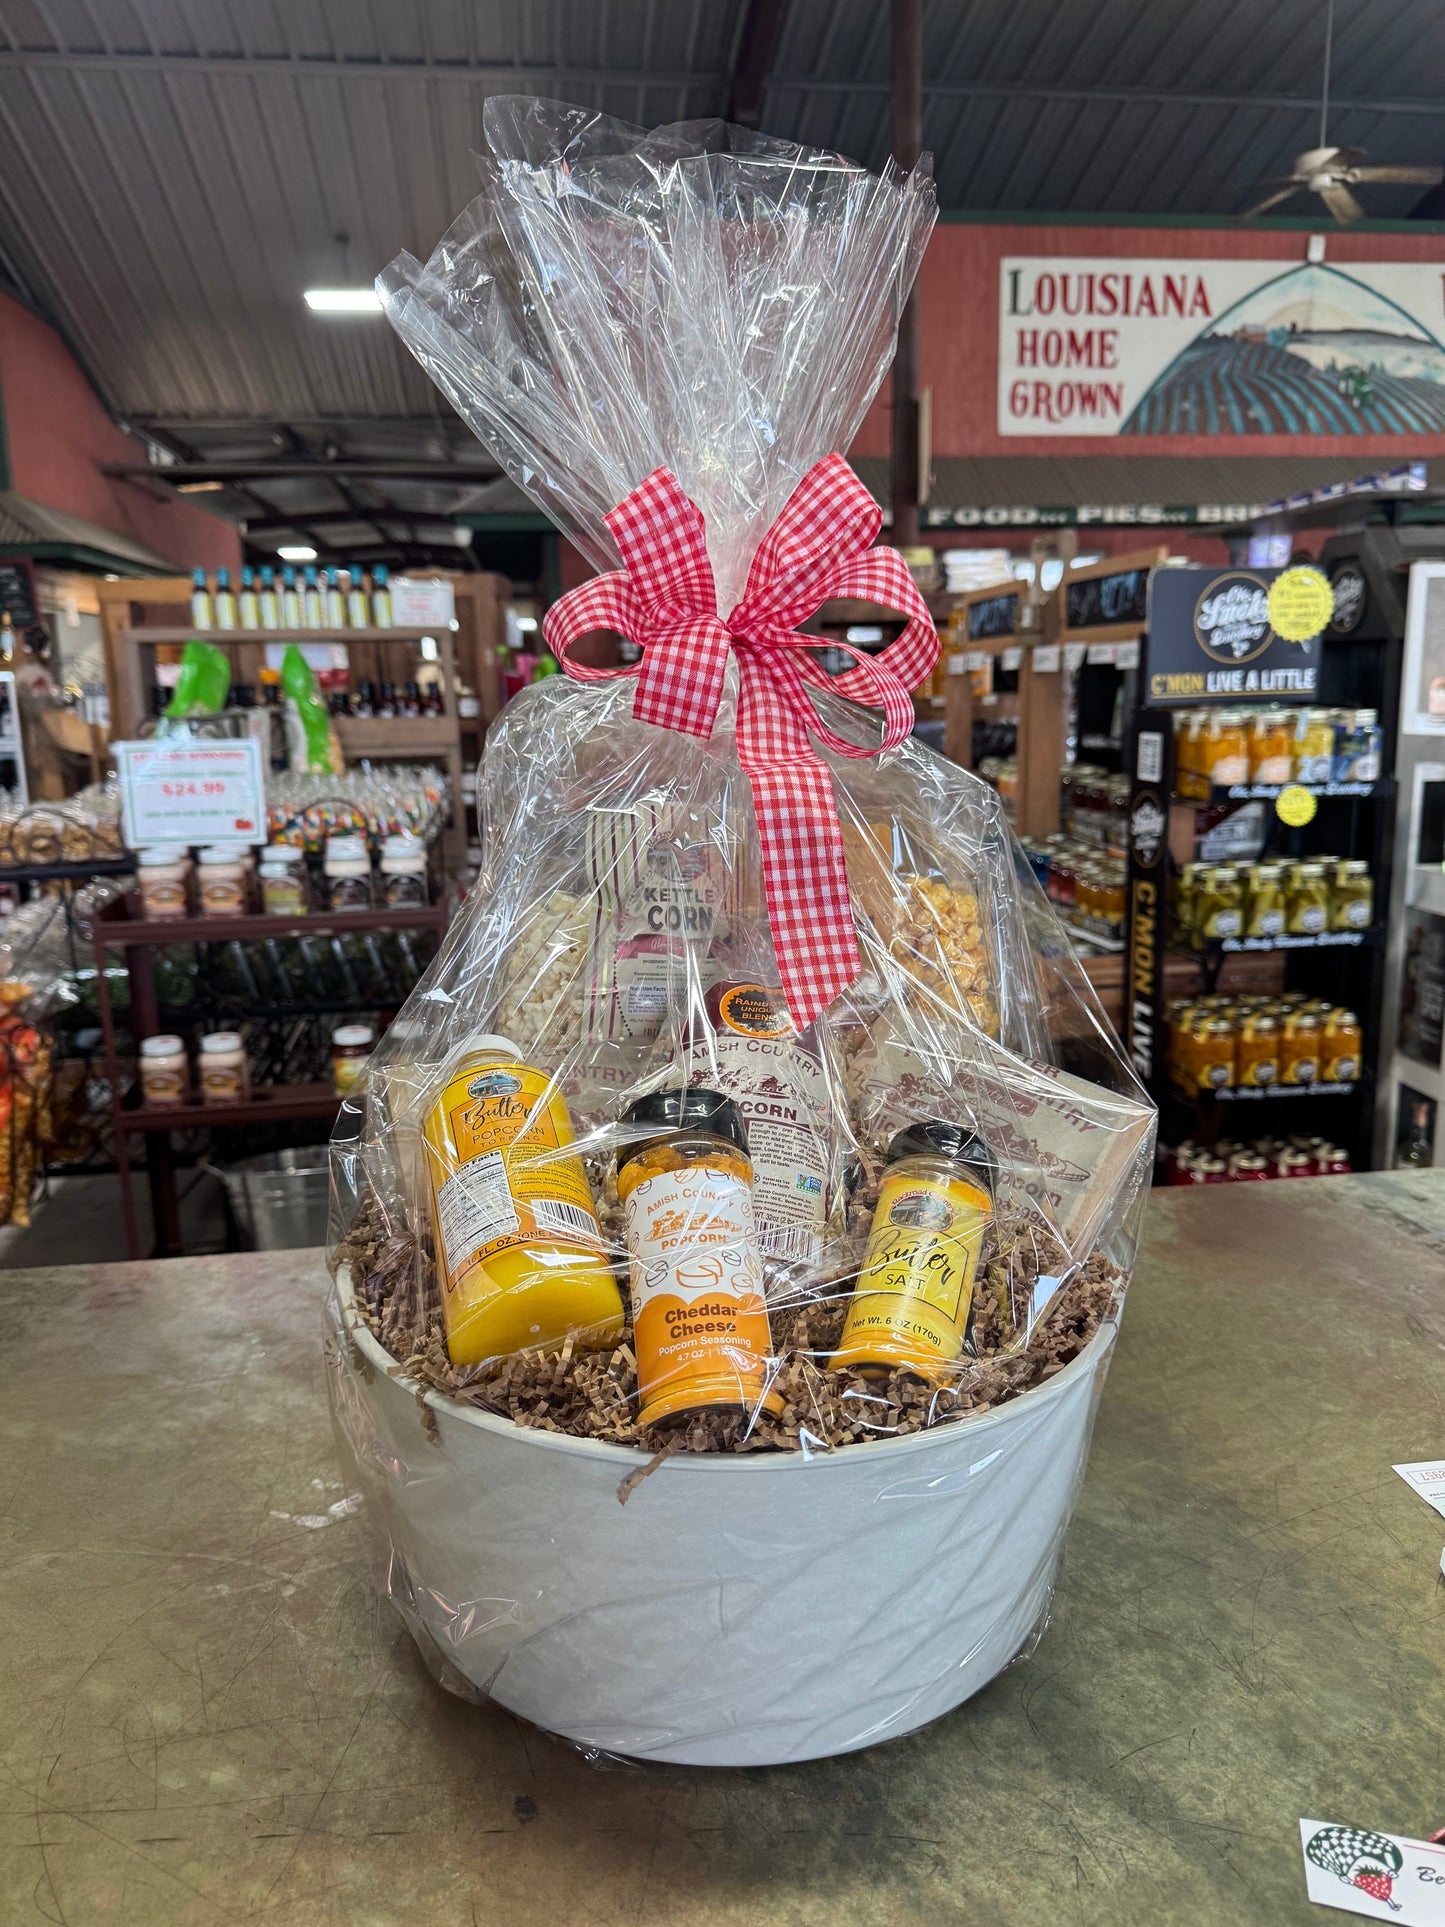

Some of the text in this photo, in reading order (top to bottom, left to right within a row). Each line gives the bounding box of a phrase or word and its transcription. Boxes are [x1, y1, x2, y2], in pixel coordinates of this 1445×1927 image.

[1006, 268, 1213, 318] LOUISIANA
[1016, 329, 1119, 369] HOME
[1009, 381, 1125, 423] GROWN
[1197, 588, 1269, 630] Smok
[1151, 667, 1317, 696] C'MON LIVE A LITTLE
[644, 886, 714, 904] KETTLE
[647, 905, 713, 932] CORN
[1132, 879, 1158, 994] C'MON
[1131, 1001, 1154, 1080] LIVE
[691, 1039, 820, 1078] AMSH COUNTRY
[472, 1125, 546, 1144] POPCORN
[480, 1135, 541, 1148] TOPPNG
[646, 1193, 679, 1217] AMISH
[466, 1255, 477, 1267] 16
[478, 1247, 494, 1258] FL.
[496, 1236, 515, 1248] OZ.
[661, 1234, 727, 1250] POPCORN
[868, 1229, 956, 1286] Butter
[884, 1273, 926, 1291] SALT
[664, 1303, 738, 1325] Cheddar
[669, 1321, 737, 1340] Cheese
[852, 1316, 942, 1347] Net Wt. 6 OZ (170g)
[659, 1335, 752, 1357] Popcorn Seasoning
[677, 1352, 690, 1362] 4.7
